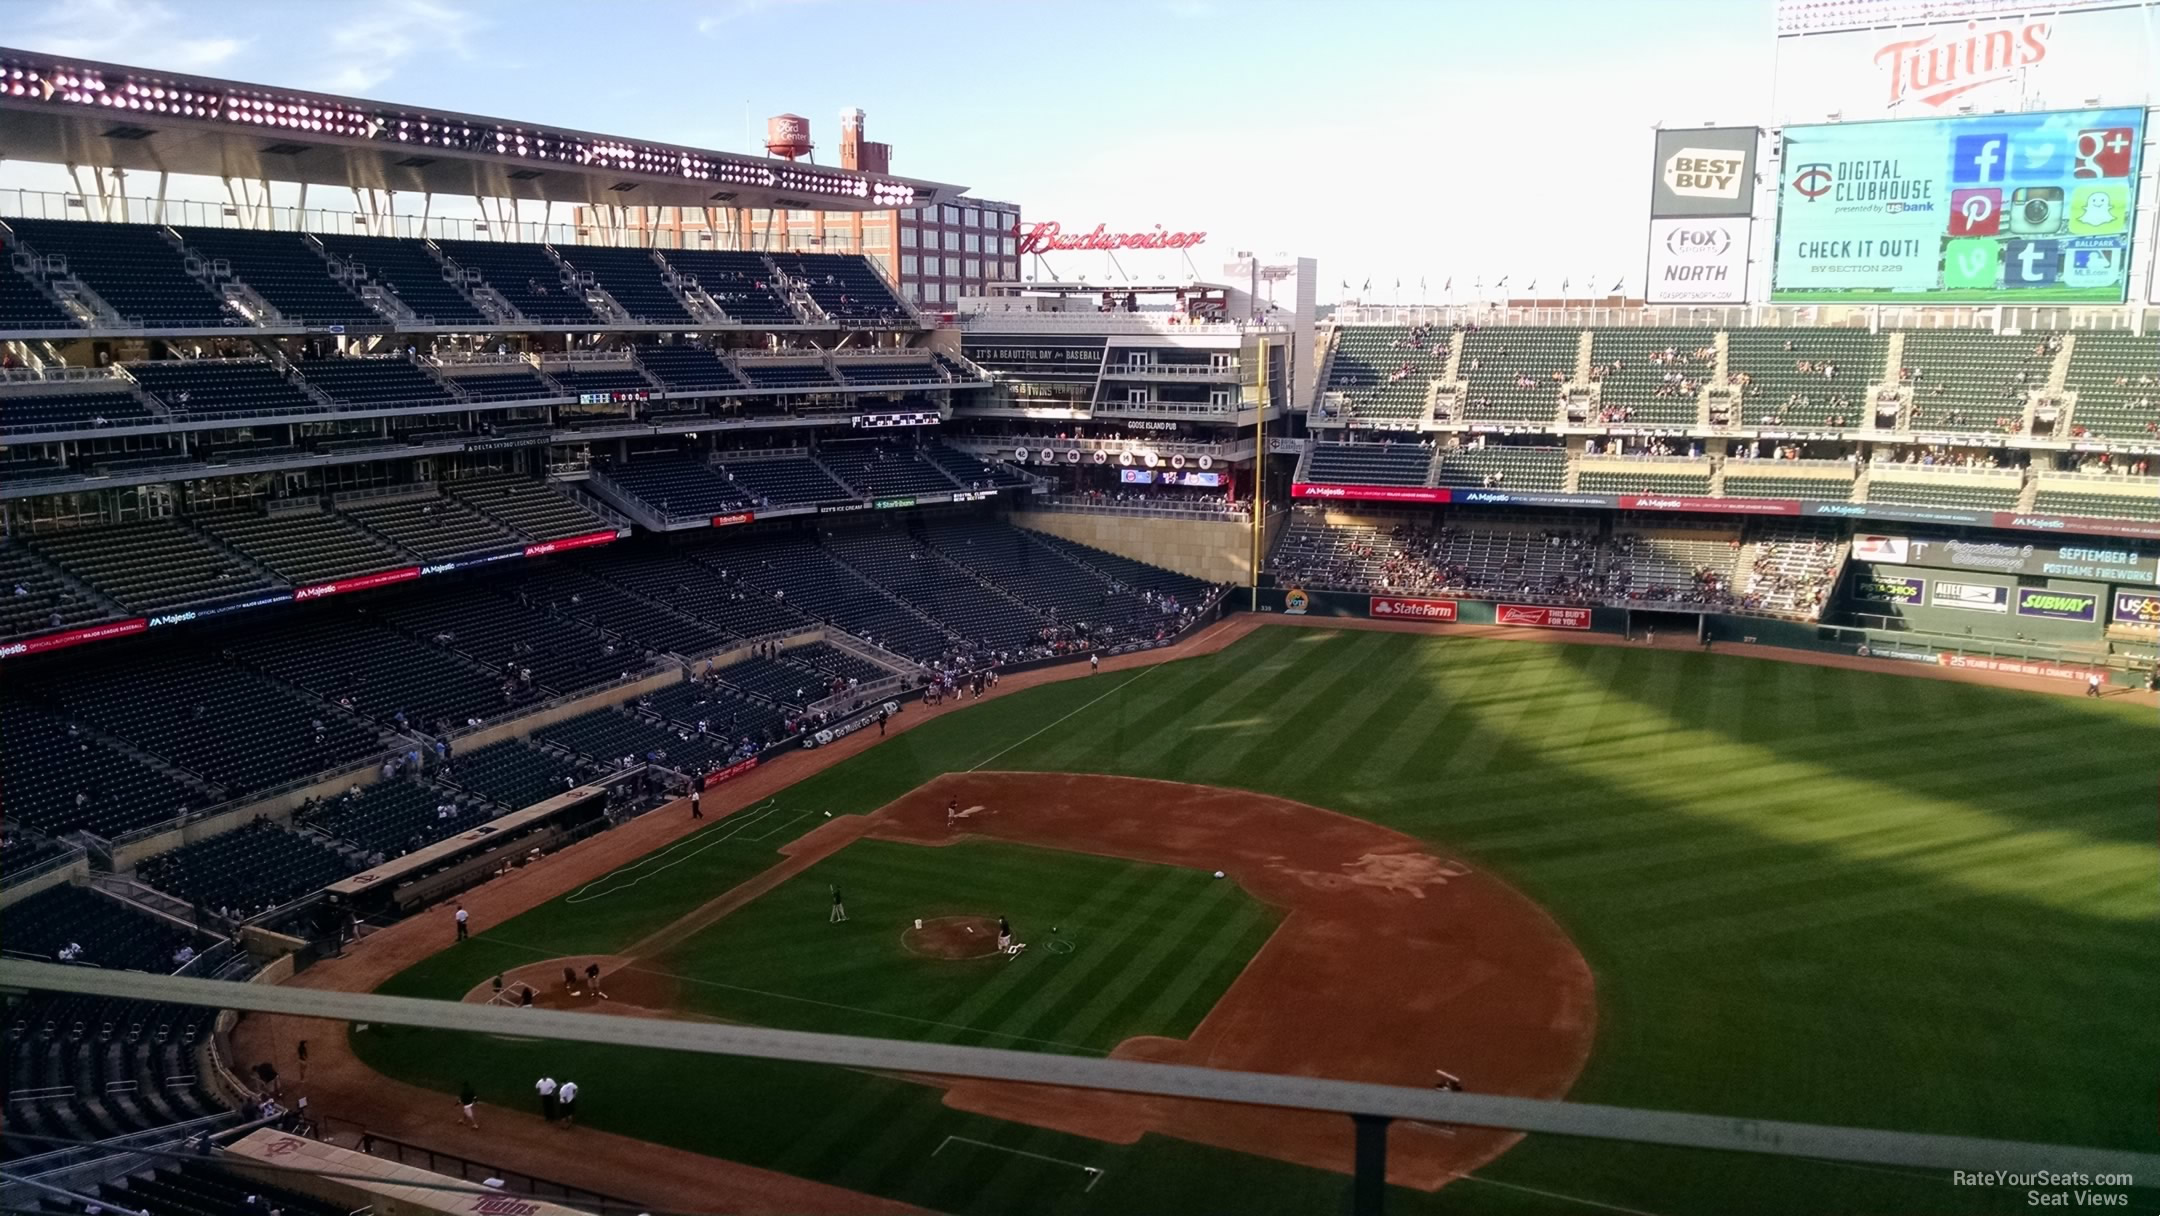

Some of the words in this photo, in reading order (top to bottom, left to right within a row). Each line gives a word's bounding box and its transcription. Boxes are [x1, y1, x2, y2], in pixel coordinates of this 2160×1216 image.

[1873, 22, 2046, 104] Twins
[776, 120, 798, 132] Ford
[781, 132, 807, 140] Center
[1676, 157, 1741, 174] BEST
[1838, 160, 1902, 180] DIGITAL
[1676, 174, 1733, 189] BUY
[1836, 180, 1932, 201] CLUBHOUSE
[1835, 205, 1872, 213] presented
[1873, 205, 1883, 213] by
[1011, 221, 1207, 254] Budweiser
[1680, 230, 1717, 245] FOX
[1799, 241, 1851, 258] CHECK
[1858, 241, 1873, 257] IT
[1880, 240, 1919, 257] OUT!
[1664, 265, 1728, 280] NORTH
[977, 350, 991, 359] IT'S
[993, 350, 997, 358] A
[1000, 350, 1037, 359] BEAUTIFUL
[1040, 351, 1052, 359] DAY
[1066, 351, 1100, 360] BASEBALL
[1020, 384, 1026, 393] IS
[1027, 384, 1052, 396] TWINS
[1128, 421, 1145, 429] GOOSE
[1146, 422, 1165, 430] ISLAND
[1317, 488, 1345, 496] Majestic
[1479, 493, 1508, 503] Majestic
[1650, 499, 1681, 508] Majestic
[1832, 507, 1866, 516] Majestic
[2027, 519, 2064, 528] Majestic
[534, 544, 554, 553] Majestic
[2059, 548, 2127, 564] SEPTEMBER
[2129, 554, 2138, 564] 2
[431, 563, 455, 573] Majestic
[2043, 563, 2093, 576] POSTGAME
[2096, 568, 2153, 581] FIREWORKS
[308, 585, 336, 596] Majestic
[1860, 583, 1917, 597] PISTACHIOS
[2022, 595, 2093, 612] SUBWAY
[162, 611, 196, 624] Majestic
[198, 609, 216, 617] OFFICIAL
[1563, 618, 1578, 626] YOU.
[30, 641, 52, 649] OFFICIAL
[83, 631, 100, 639] MAJOR
[101, 628, 118, 636] LEAGUE
[120, 623, 143, 632] BASEBALL
[1951, 657, 1966, 667] 25
[1967, 660, 1988, 669] YEARS
[1989, 661, 1997, 670] OF
[1999, 662, 2021, 672] GIVING
[2022, 665, 2038, 674] KIDS
[2046, 668, 2073, 678] CHANCE
[2075, 671, 2085, 680] TO
[835, 729, 844, 737] Go
[845, 721, 860, 733] Music
[862, 718, 870, 727] Go
